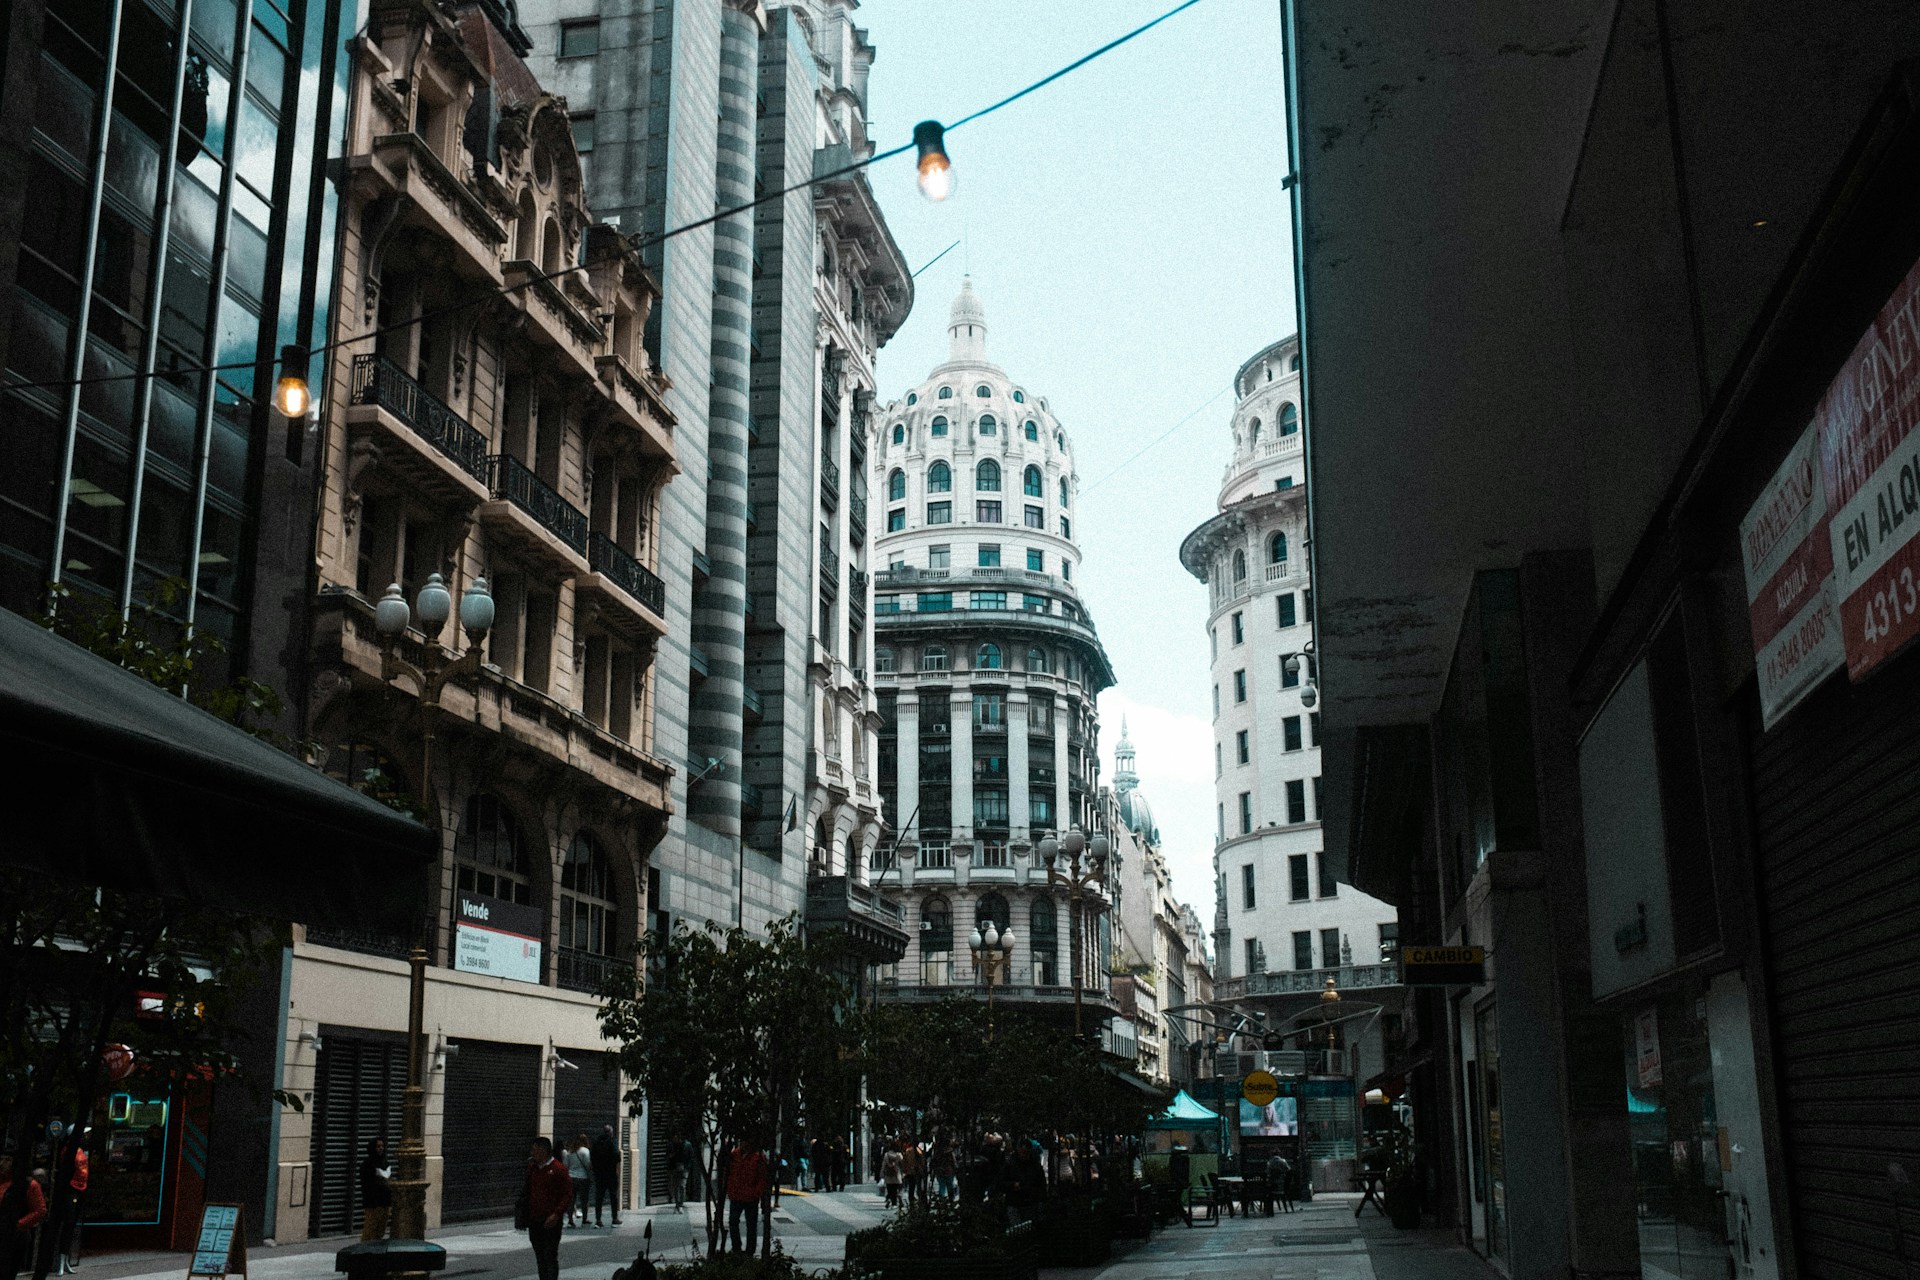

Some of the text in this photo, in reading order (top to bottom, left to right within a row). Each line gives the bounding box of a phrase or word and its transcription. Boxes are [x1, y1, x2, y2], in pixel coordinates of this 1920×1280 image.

[1844, 513, 1869, 573] EN
[1776, 561, 1808, 615] ALQUILA
[1766, 611, 1826, 689] 11 3048 8008
[462, 899, 489, 920] Vende
[1413, 950, 1473, 962] CAMBIO
